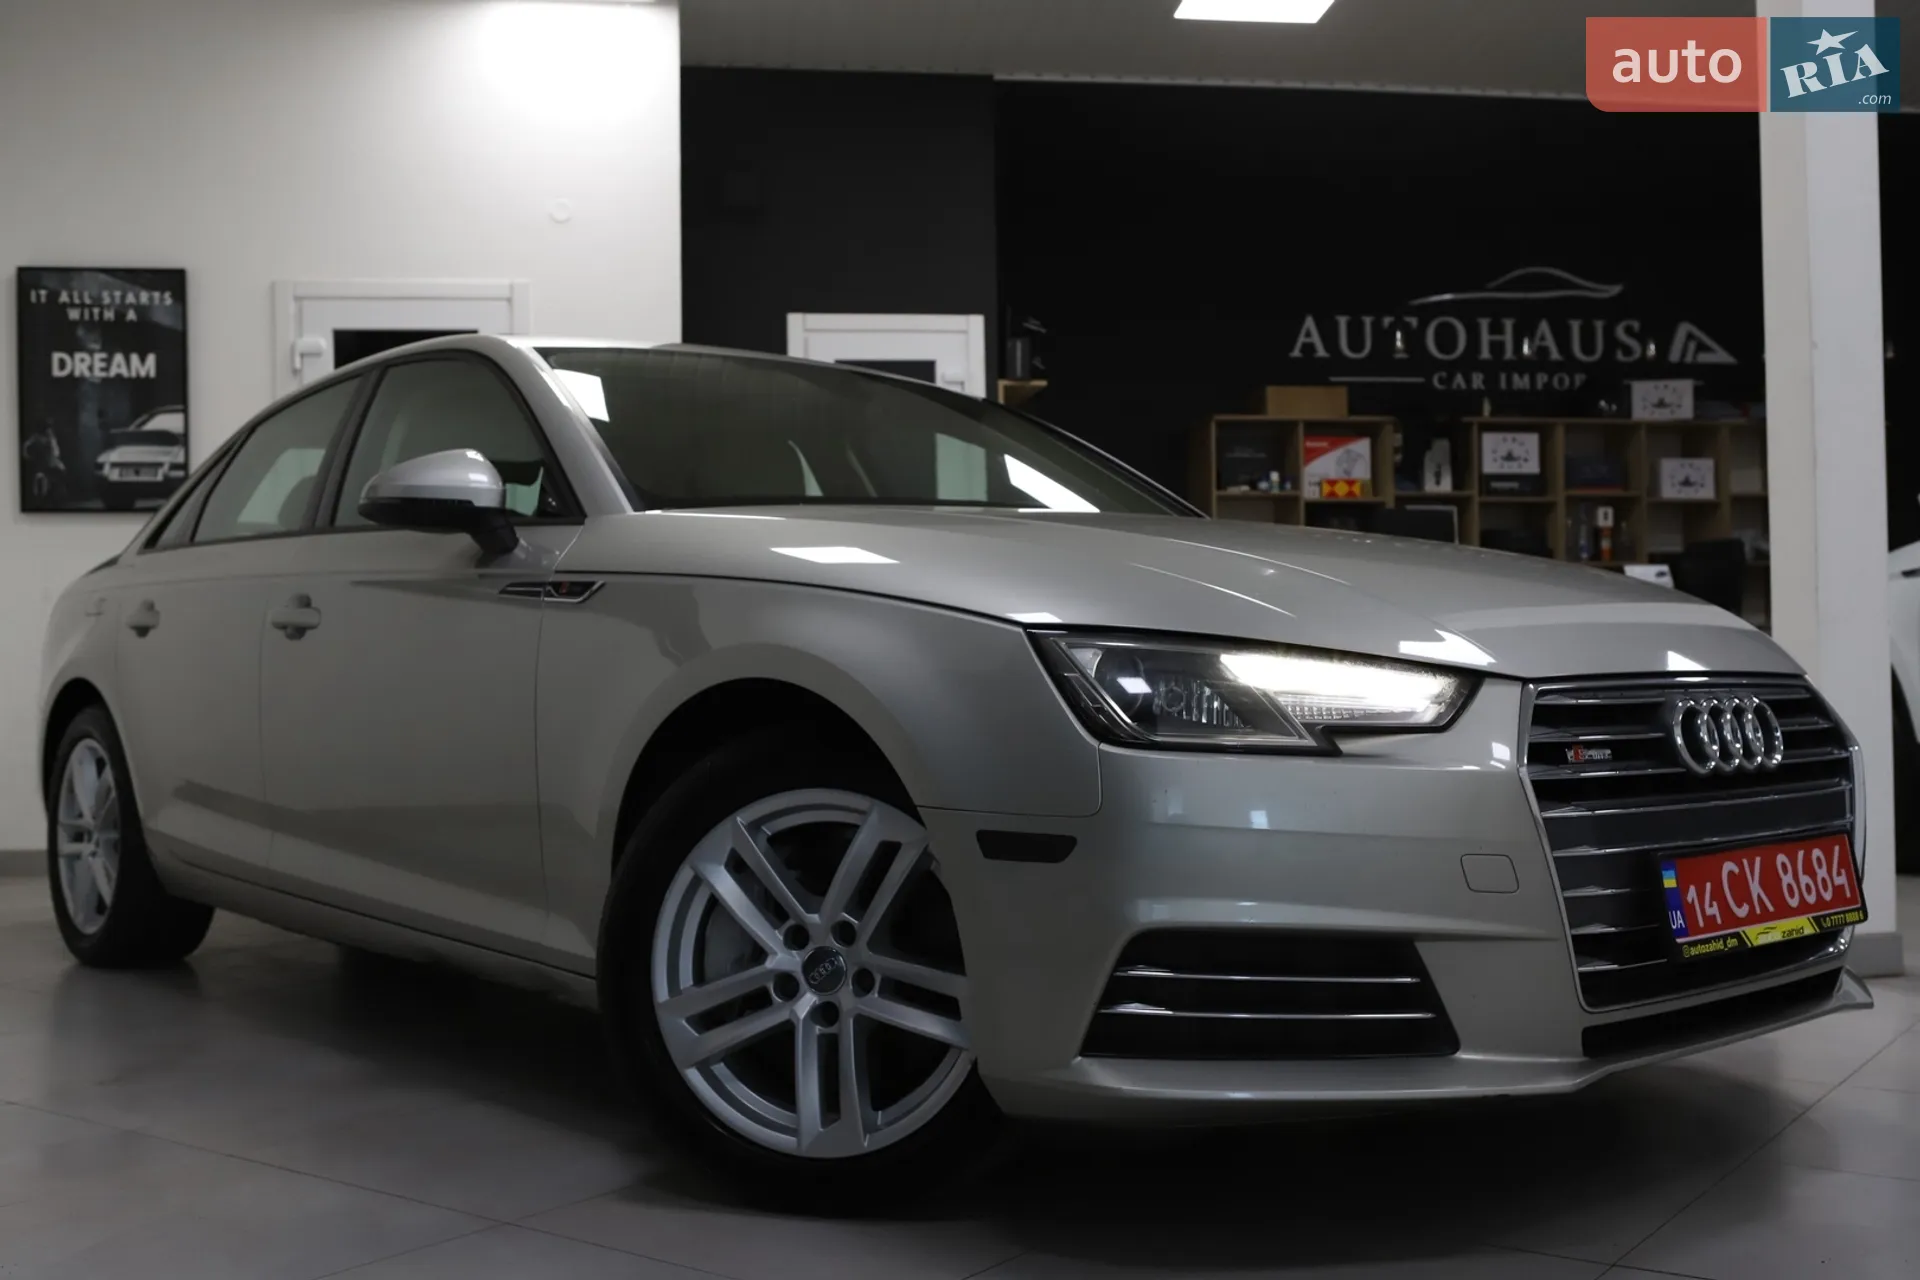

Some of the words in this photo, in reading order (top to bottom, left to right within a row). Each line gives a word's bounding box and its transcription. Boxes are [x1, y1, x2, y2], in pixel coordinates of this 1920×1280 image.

[30, 289, 48, 304] IT
[58, 290, 93, 305] ALL
[103, 290, 174, 306] STARTS
[66, 307, 116, 322] WITH
[125, 308, 138, 322] A
[1289, 314, 1643, 362] AUTOHAUS
[51, 352, 157, 378] DREAM
[1432, 372, 1487, 390] CAR
[1776, 845, 1851, 908] 8684
[1669, 910, 1686, 930] UA
